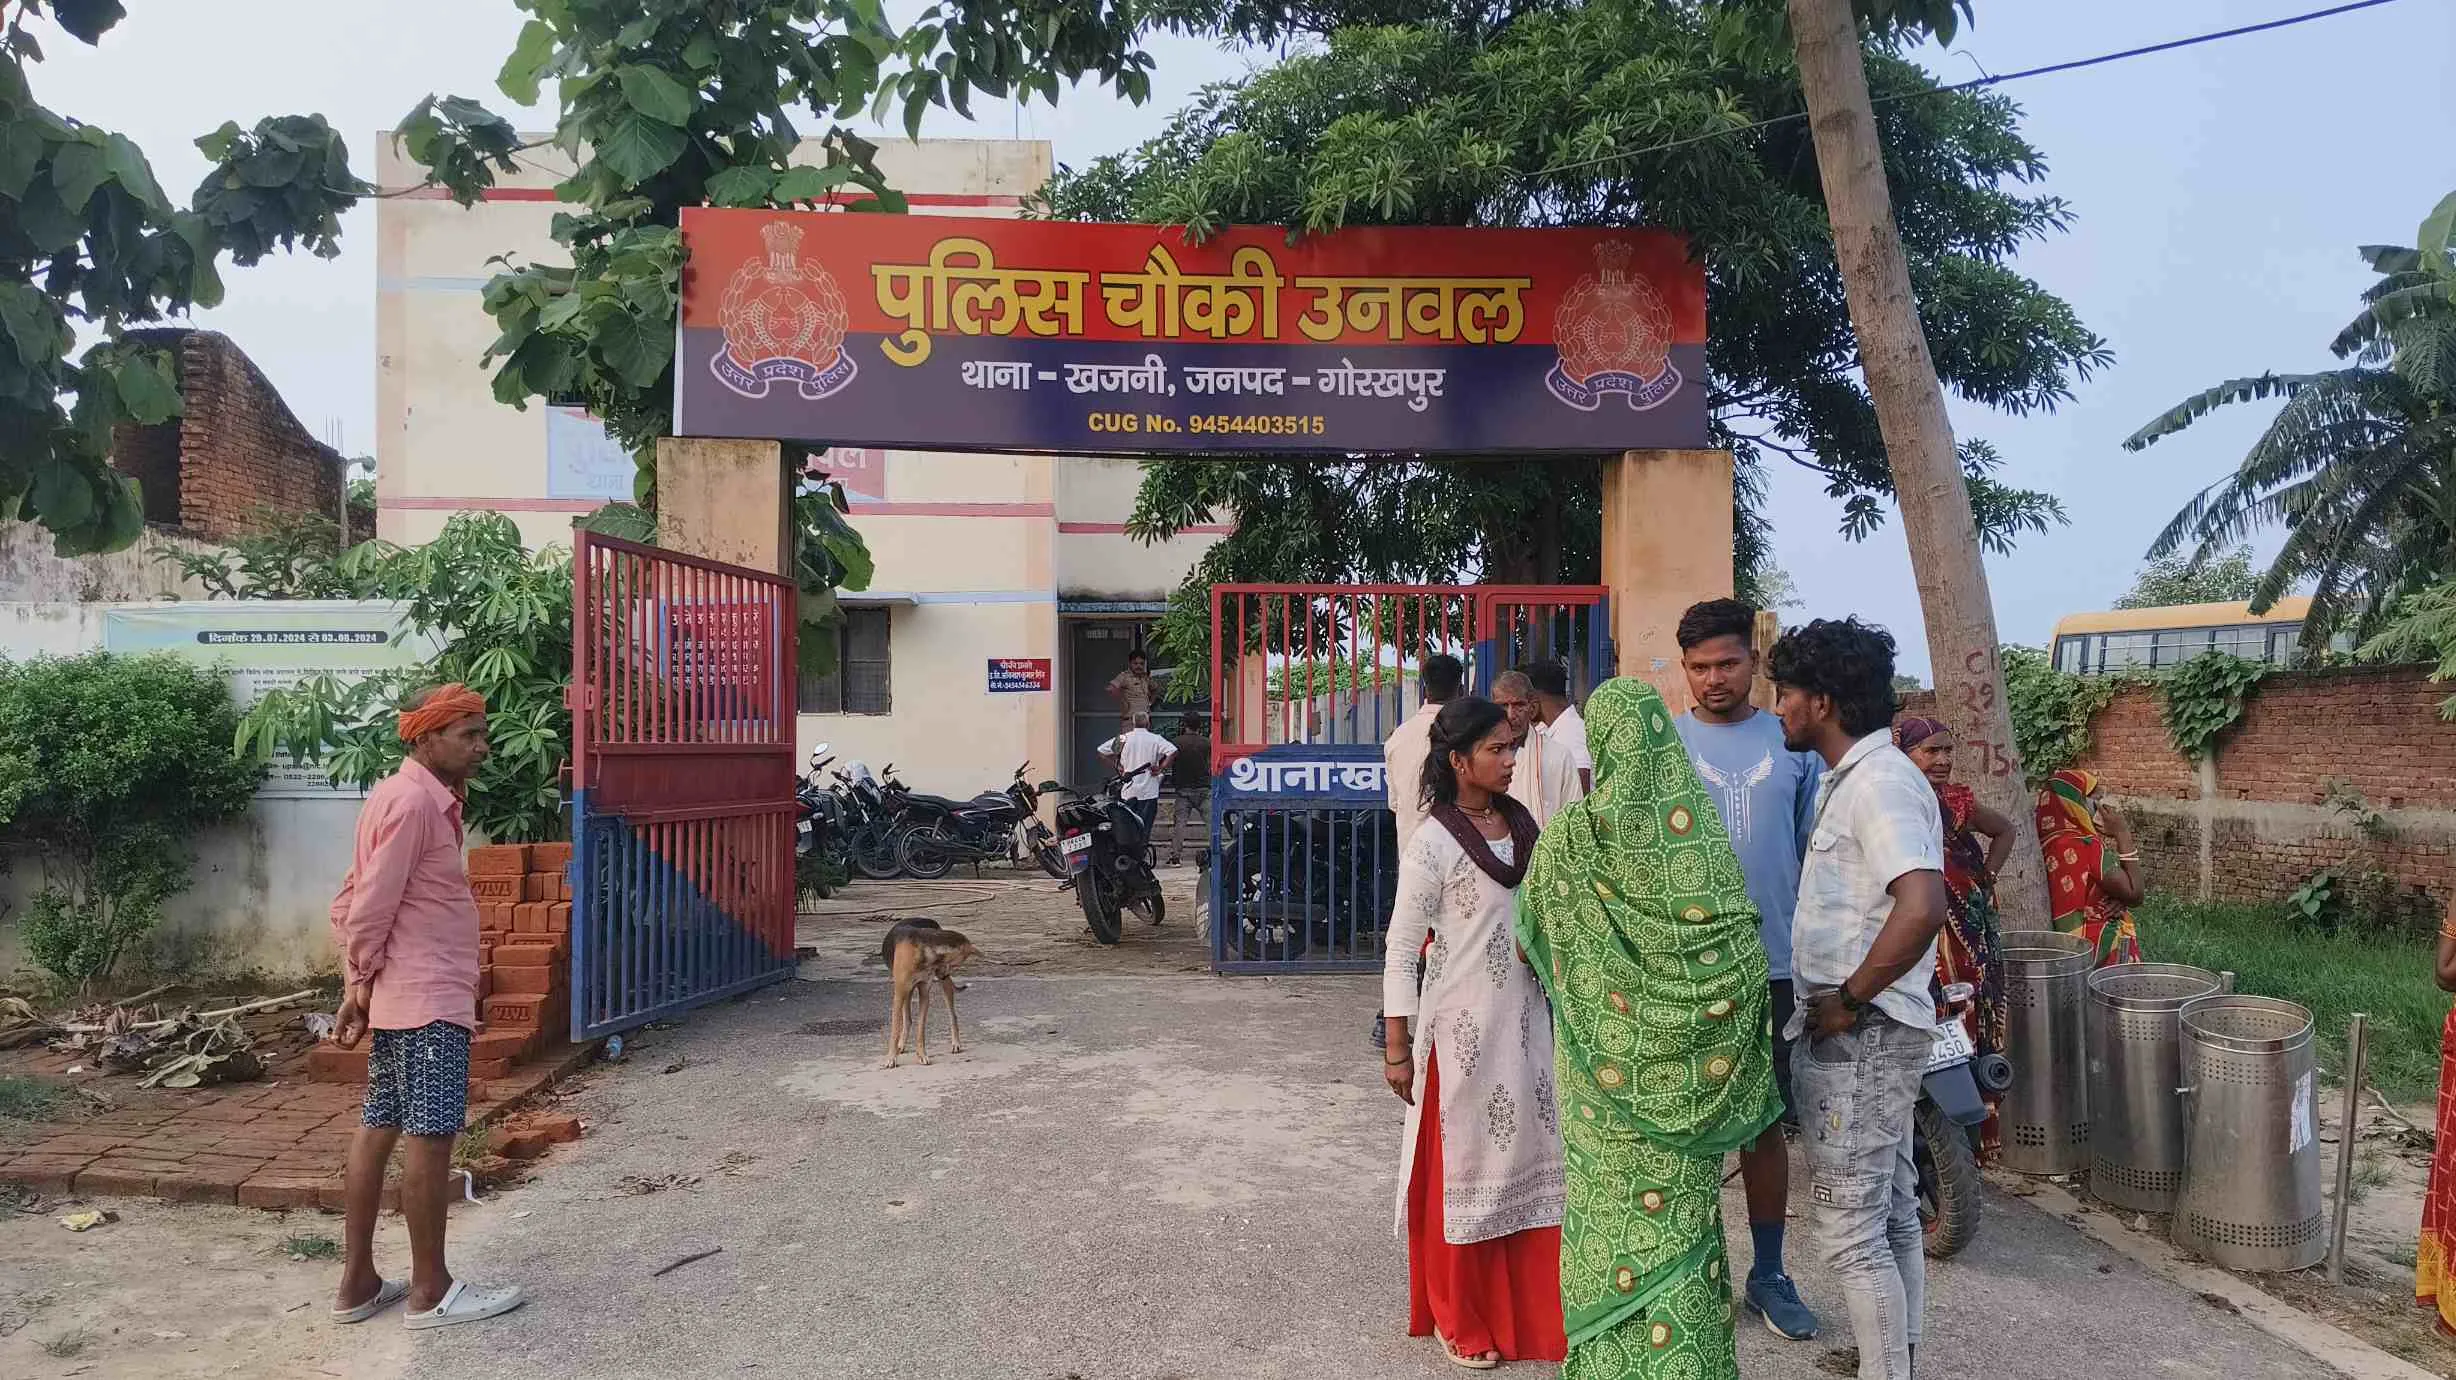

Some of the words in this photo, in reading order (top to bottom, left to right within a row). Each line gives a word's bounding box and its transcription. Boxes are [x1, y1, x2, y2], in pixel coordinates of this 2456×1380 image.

[871, 237, 1089, 367] पुलिस
[1100, 241, 1286, 339] चौकी
[1295, 276, 1532, 344] उनवल
[721, 363, 755, 391] उत्तर
[762, 360, 806, 378] प्रदेश
[961, 360, 1033, 390] थाना
[1063, 353, 1176, 397] खजनी,
[1183, 366, 1287, 396] जनपद
[1316, 357, 1447, 412] गोरखपुर
[1594, 374, 1633, 391] प्रदेश
[1088, 412, 1139, 433] CUG
[1146, 414, 1183, 434] No.
[1189, 414, 1326, 435] 9454403515
